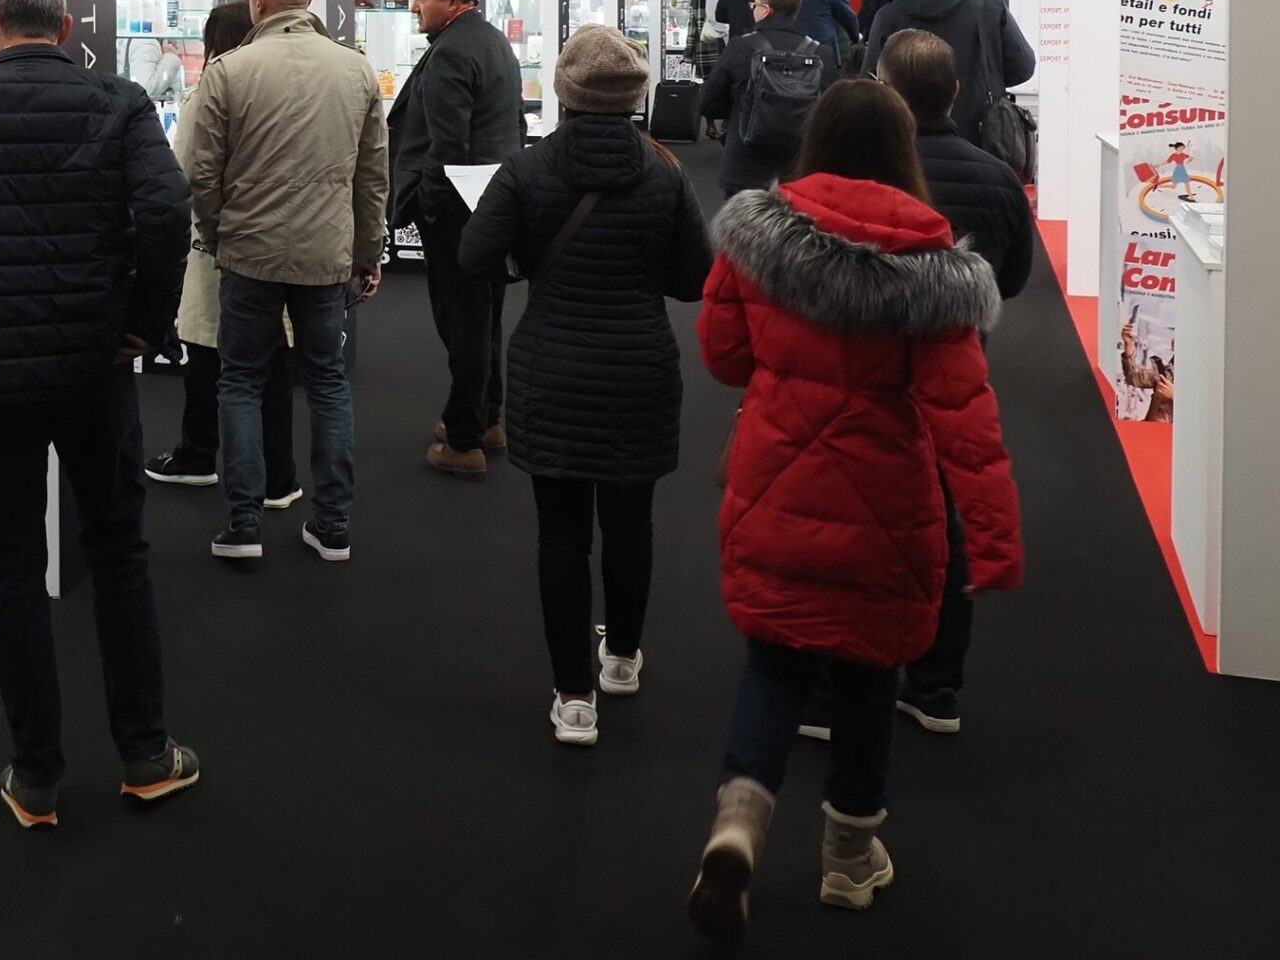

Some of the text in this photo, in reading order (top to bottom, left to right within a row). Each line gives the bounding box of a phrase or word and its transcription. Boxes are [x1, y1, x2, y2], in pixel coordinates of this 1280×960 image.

[1158, 4, 1167, 13] e
[1173, 4, 1212, 20] fondi
[1139, 16, 1165, 29] per
[1170, 20, 1202, 35] tutti
[1124, 242, 1176, 267] Lar
[1124, 267, 1175, 292] Con
